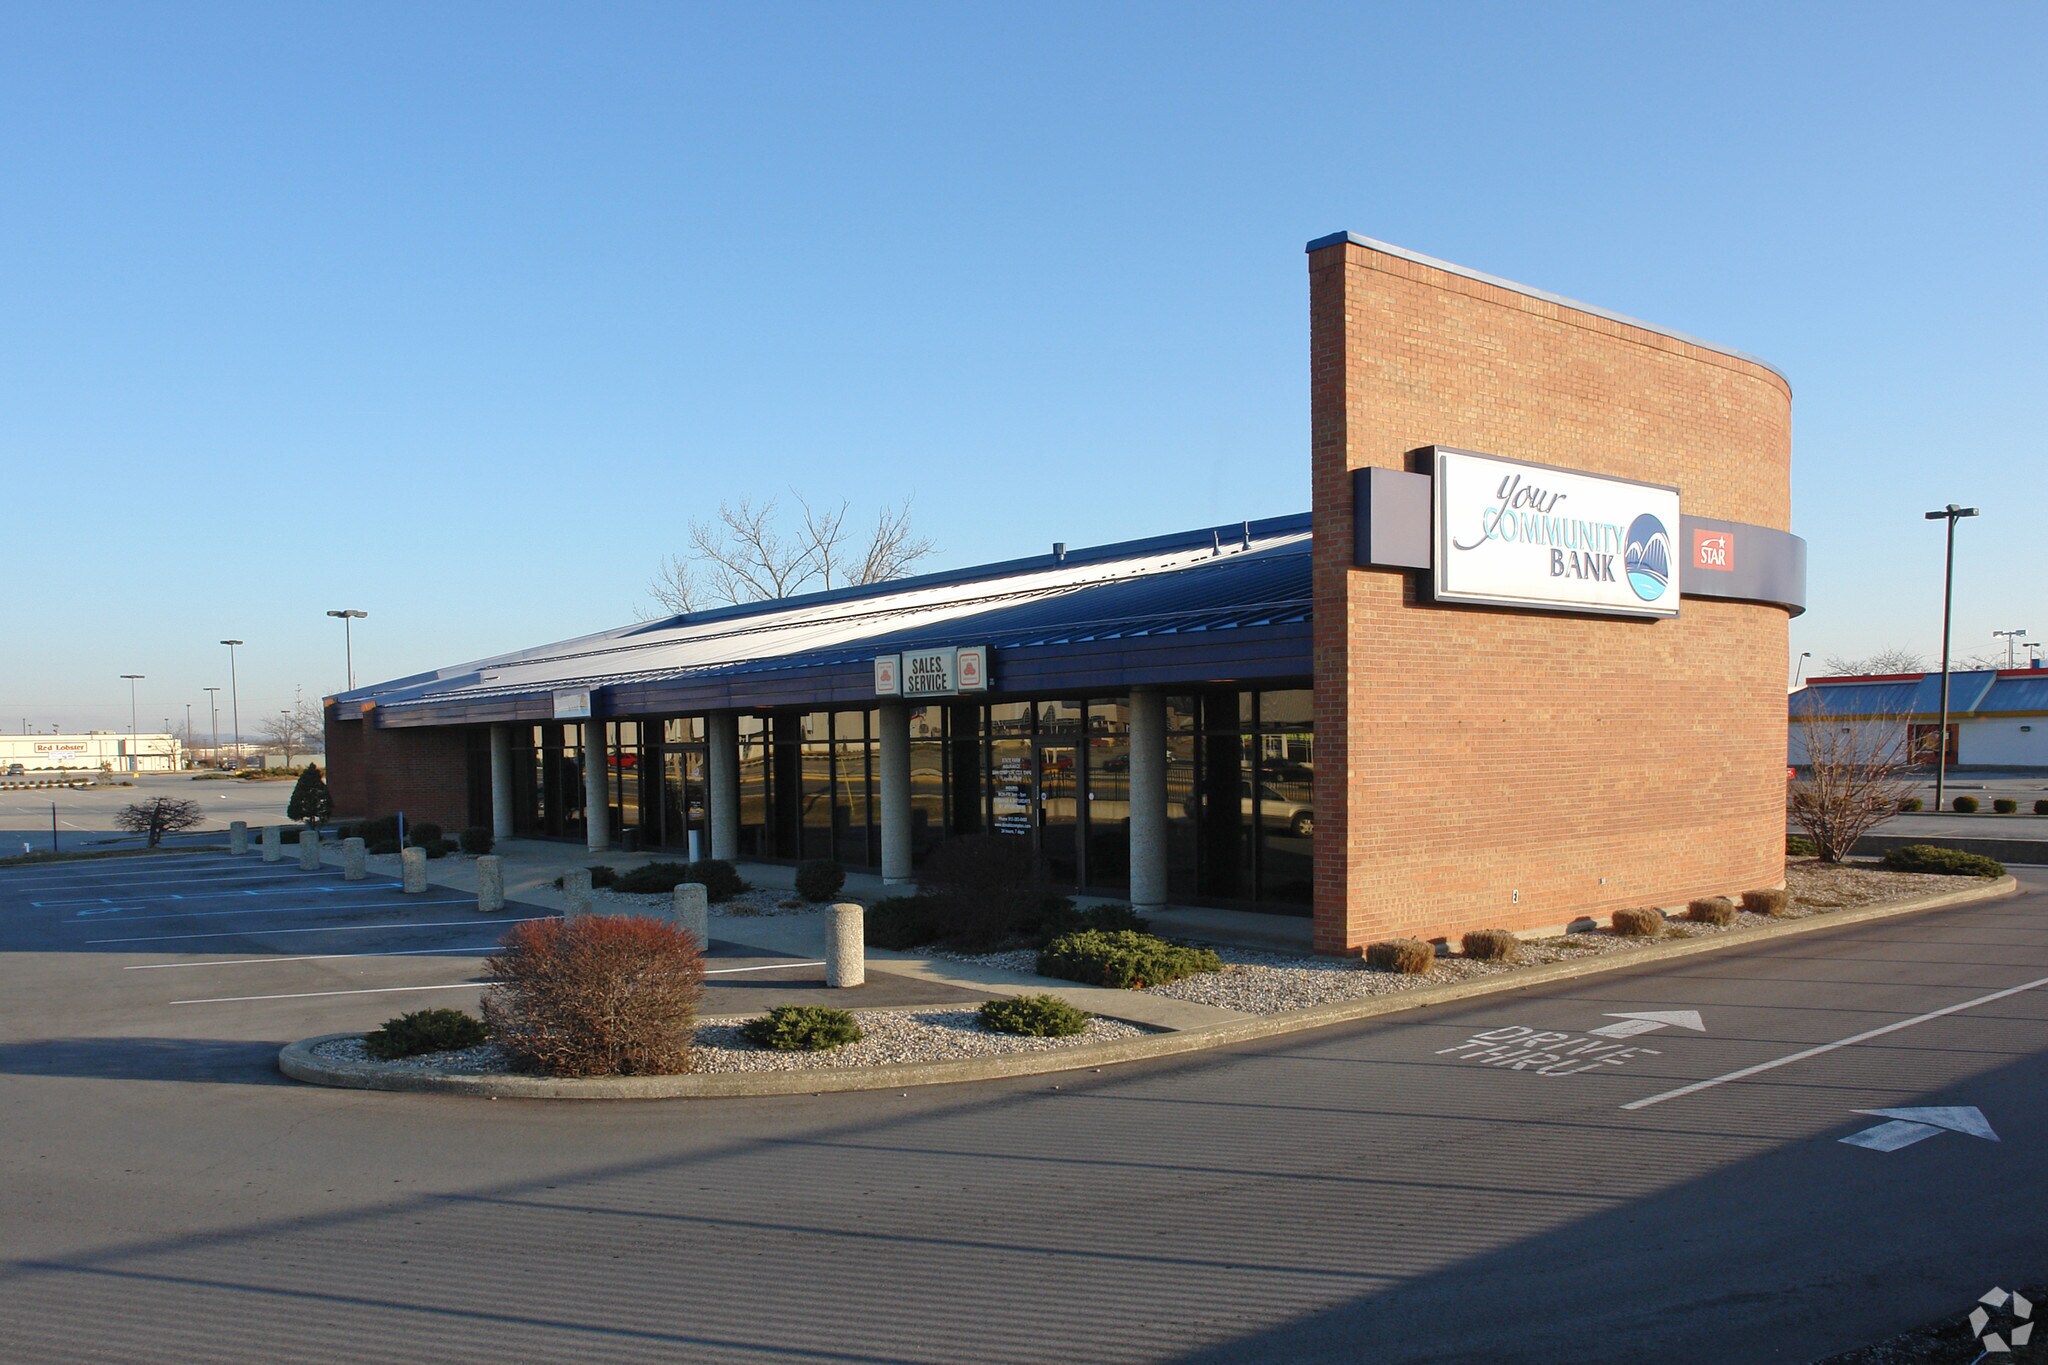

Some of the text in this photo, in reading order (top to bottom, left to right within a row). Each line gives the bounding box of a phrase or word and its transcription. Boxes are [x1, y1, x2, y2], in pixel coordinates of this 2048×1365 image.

[1483, 507, 1625, 554] COMMUNITY
[1550, 548, 1616, 582] BANK
[1700, 546, 1726, 566] STAR
[908, 673, 947, 692] SERVICE
[1434, 1039, 1602, 1077] THRU
[1472, 1025, 1662, 1065] DRIVE
